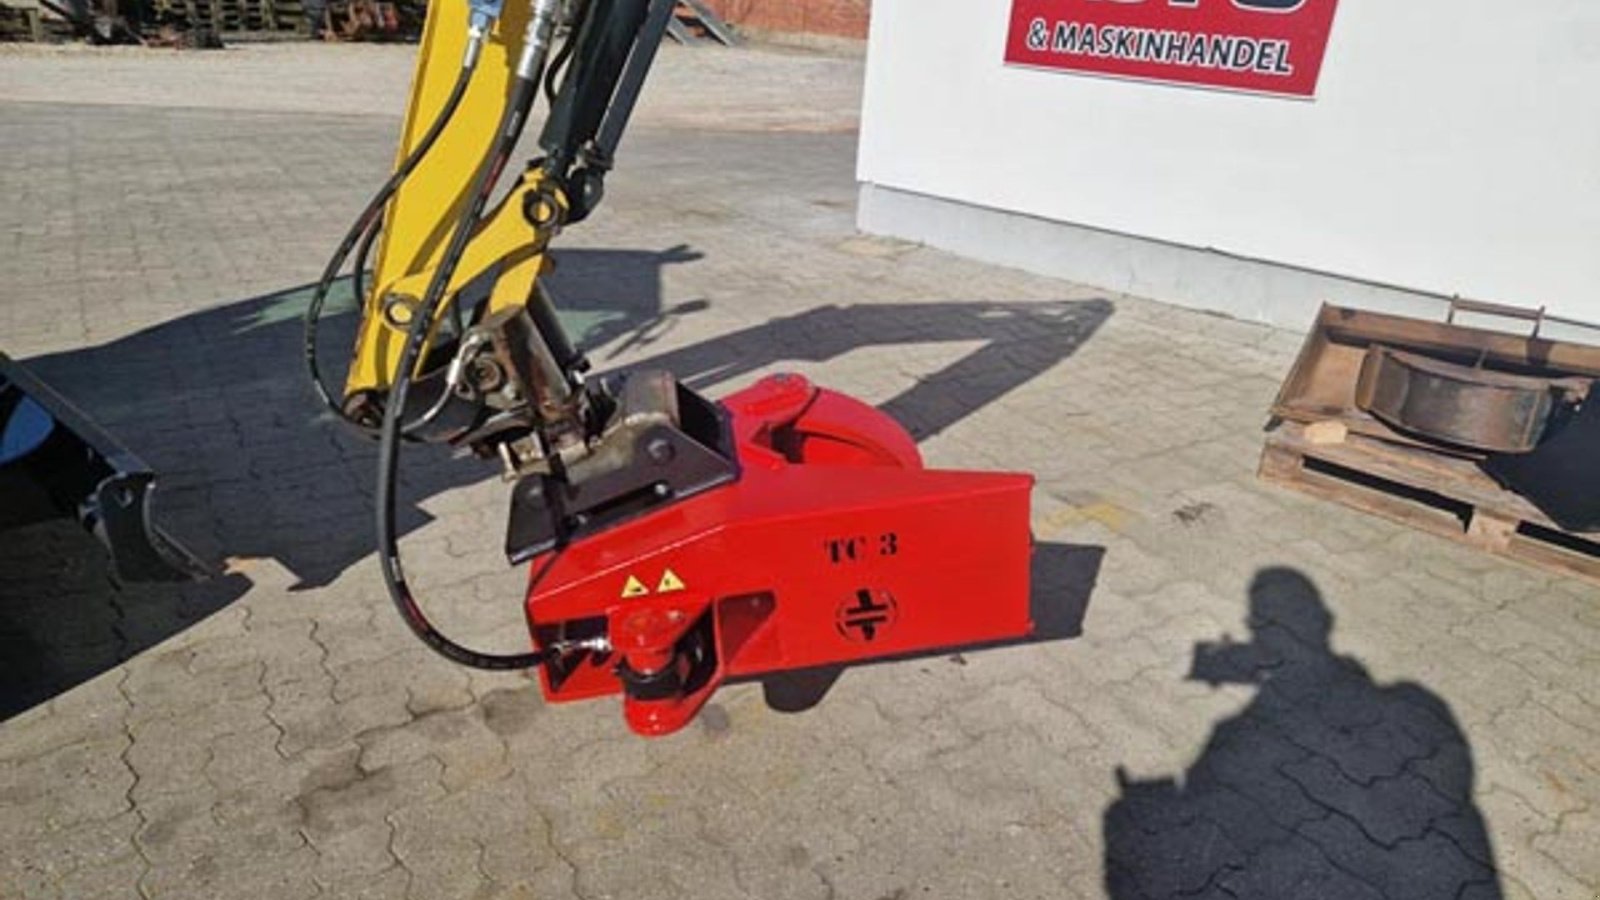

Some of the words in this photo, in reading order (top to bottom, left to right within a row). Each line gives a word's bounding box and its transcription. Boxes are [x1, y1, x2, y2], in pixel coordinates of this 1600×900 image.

[1029, 20, 1047, 48] &
[1054, 24, 1293, 74] MASKINHANDEL
[824, 536, 867, 563] TC
[880, 532, 898, 556] 3
